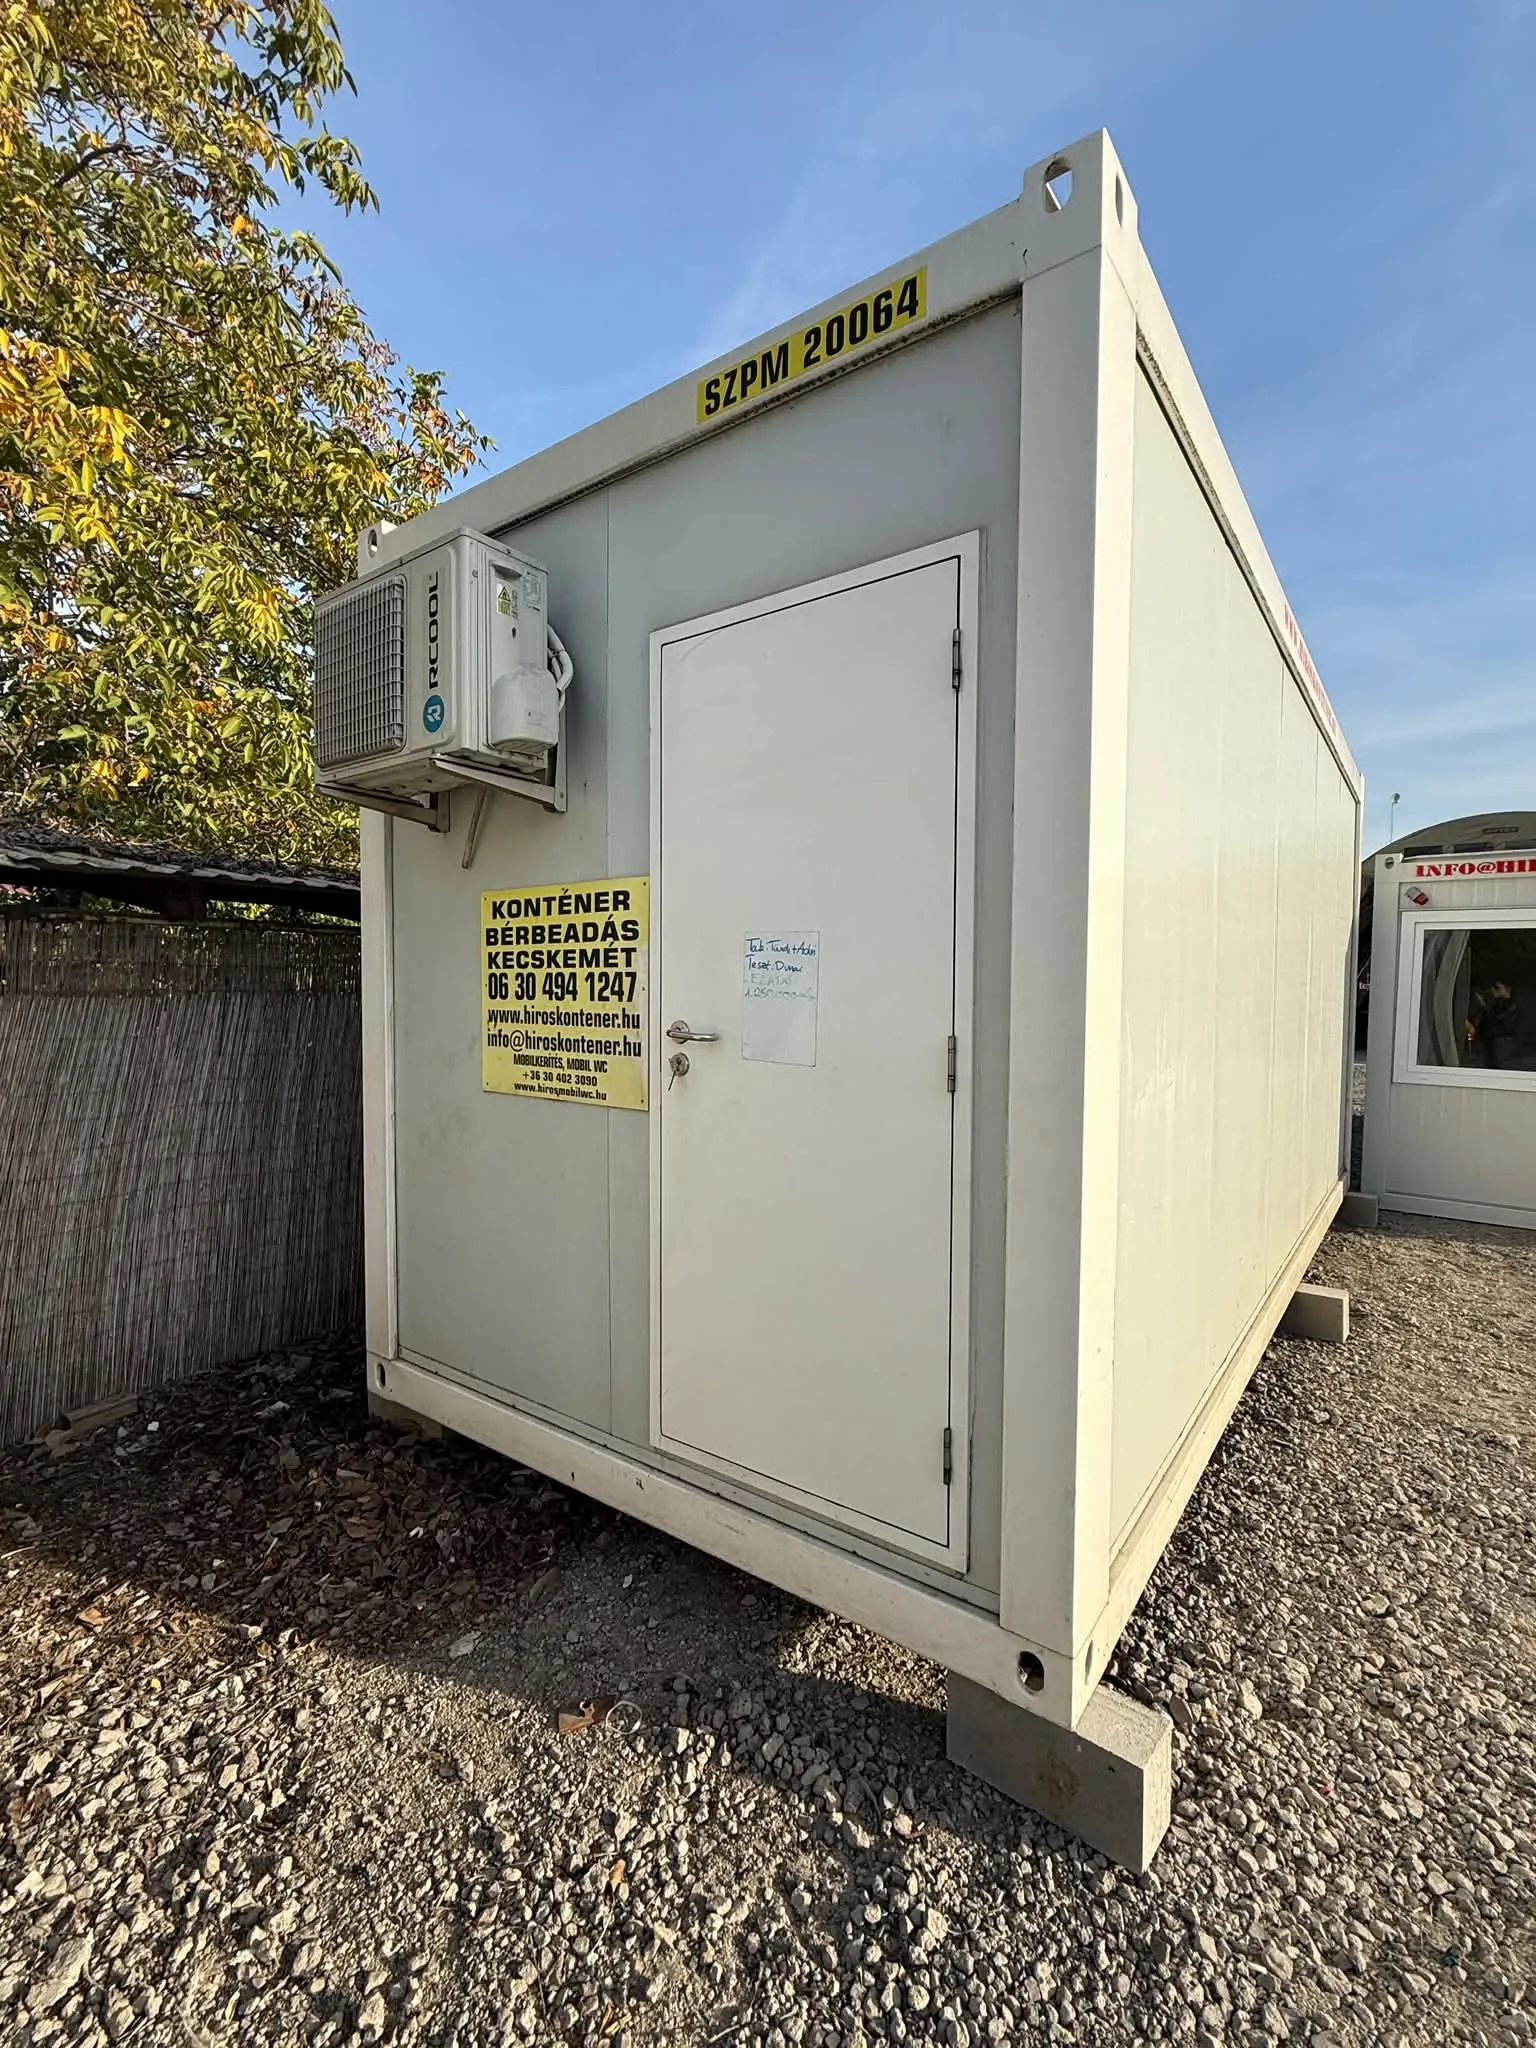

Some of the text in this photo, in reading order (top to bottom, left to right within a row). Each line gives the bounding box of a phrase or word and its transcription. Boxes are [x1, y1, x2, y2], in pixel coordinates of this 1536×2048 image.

[704, 275, 919, 416] SZPM 20064
[428, 571, 439, 689] RCOOL
[492, 888, 631, 920] KONTÉNER
[486, 914, 640, 946] BÉRBEADÁS
[487, 941, 637, 969] KECSKEMÉT
[488, 971, 637, 1002] 06 30 494 1247
[488, 1005, 640, 1029] www.hiroskontener.hu
[487, 1028, 642, 1057] info@hiroskontener.hu
[522, 1070, 598, 1087] +36 30 402 3090
[567, 1057, 592, 1072] MOBIL
[593, 1059, 608, 1073] WC
[514, 1082, 607, 1100] www.hirosmobilwc.hu
